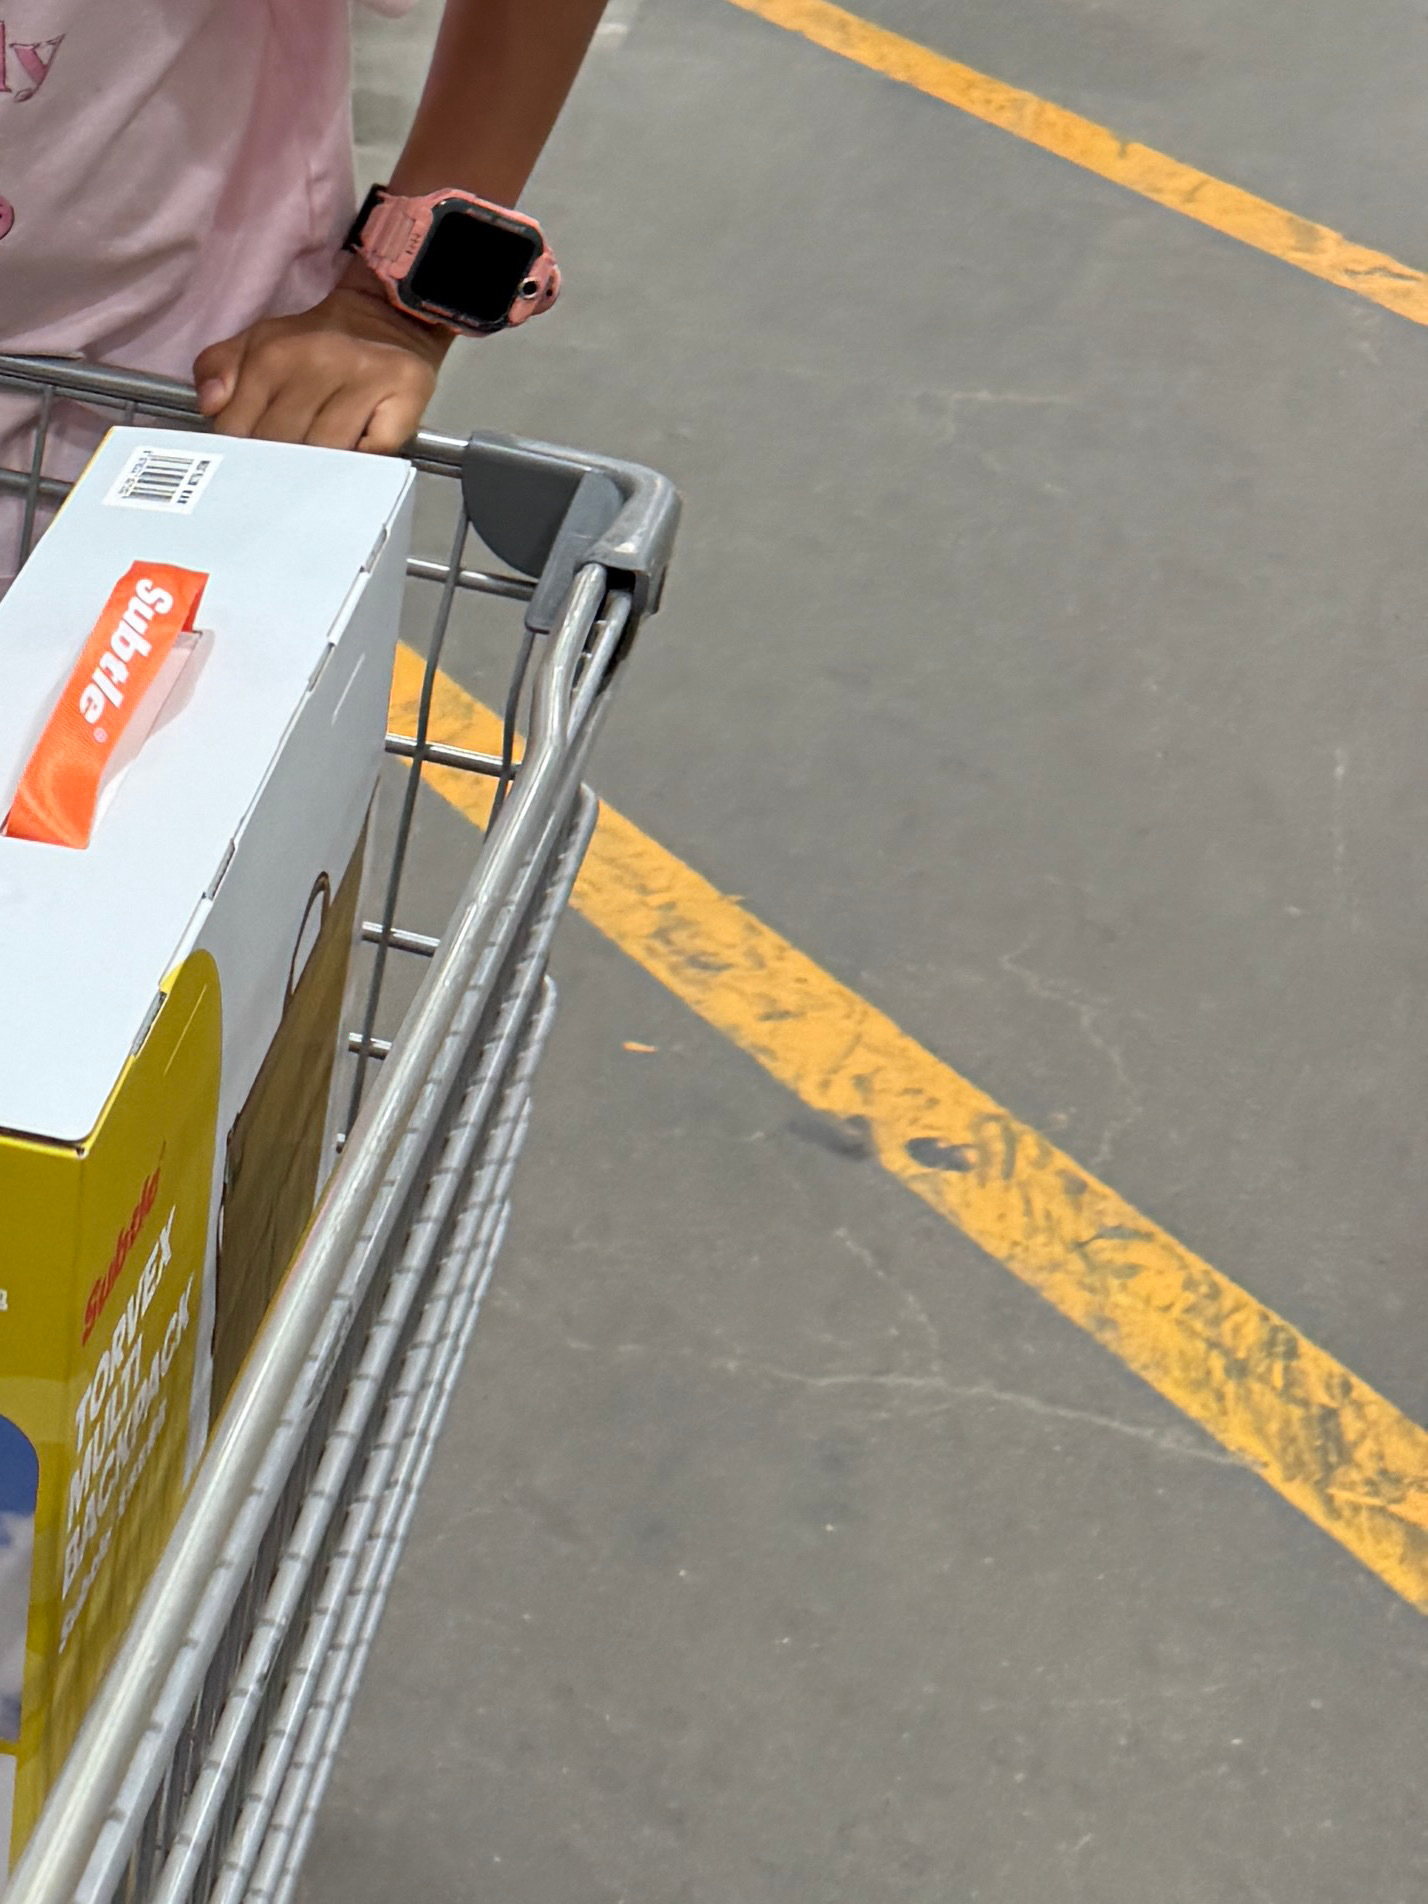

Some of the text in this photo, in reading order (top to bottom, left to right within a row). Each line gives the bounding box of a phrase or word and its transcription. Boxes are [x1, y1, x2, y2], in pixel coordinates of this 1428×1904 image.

[79, 578, 174, 726] Subtle
[62, 1272, 194, 1600] BACKPACK
[66, 1333, 142, 1532] MULTI
